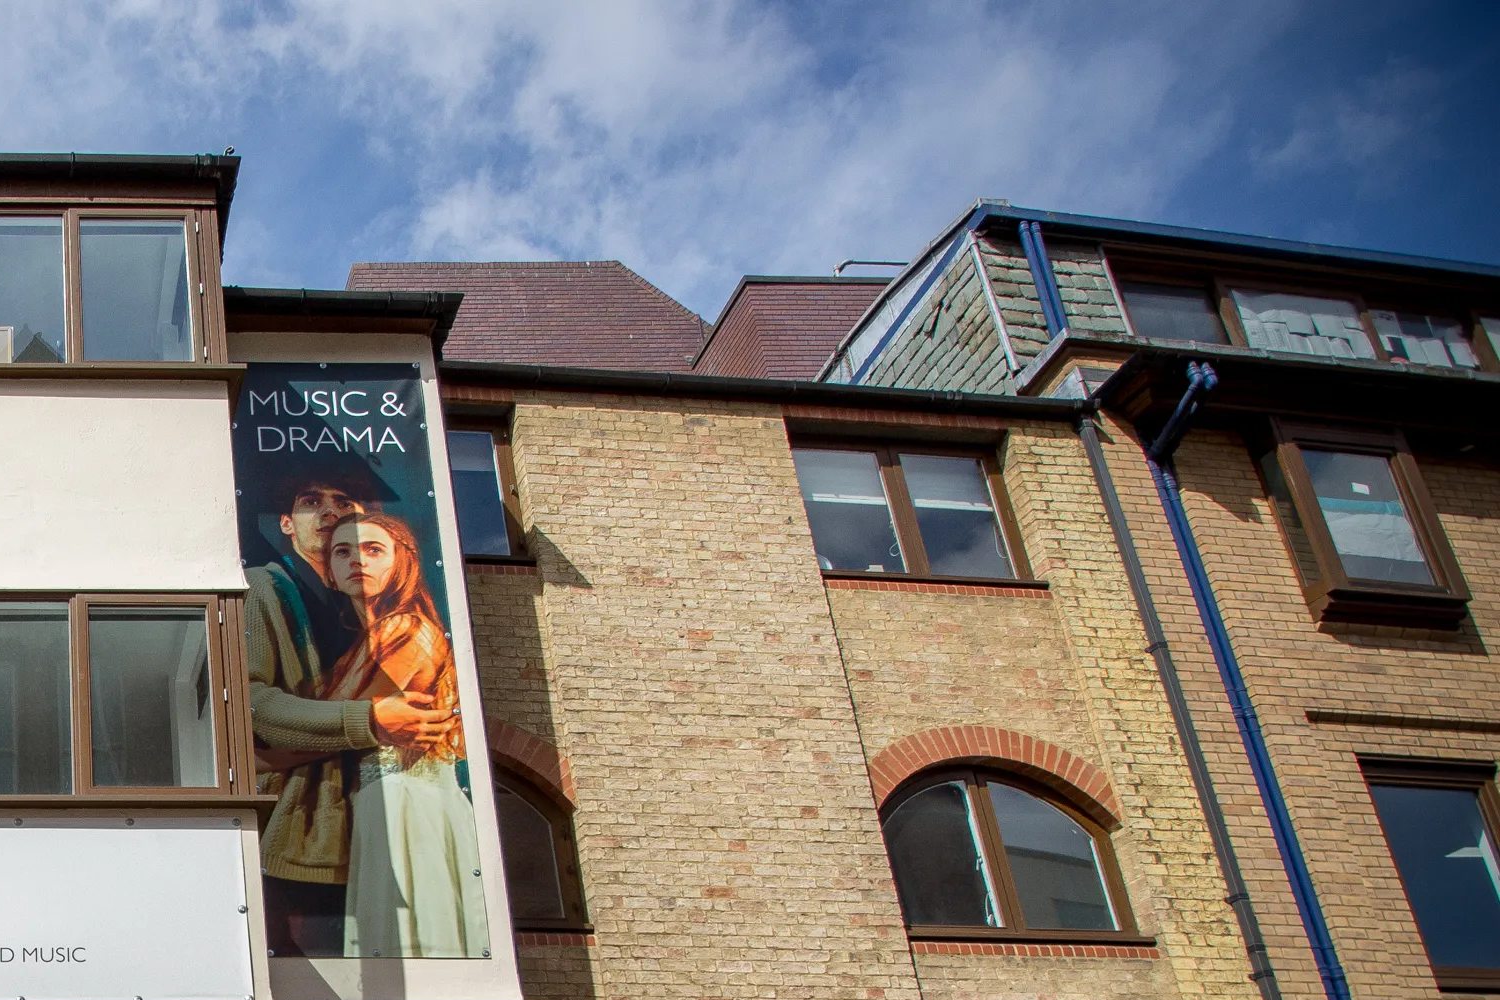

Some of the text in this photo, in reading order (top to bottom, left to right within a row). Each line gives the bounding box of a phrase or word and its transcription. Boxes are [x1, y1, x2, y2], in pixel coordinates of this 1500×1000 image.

[249, 391, 407, 417] MUSIC &
[257, 426, 405, 453] DRAMA
[22, 947, 86, 963] MUSIC
